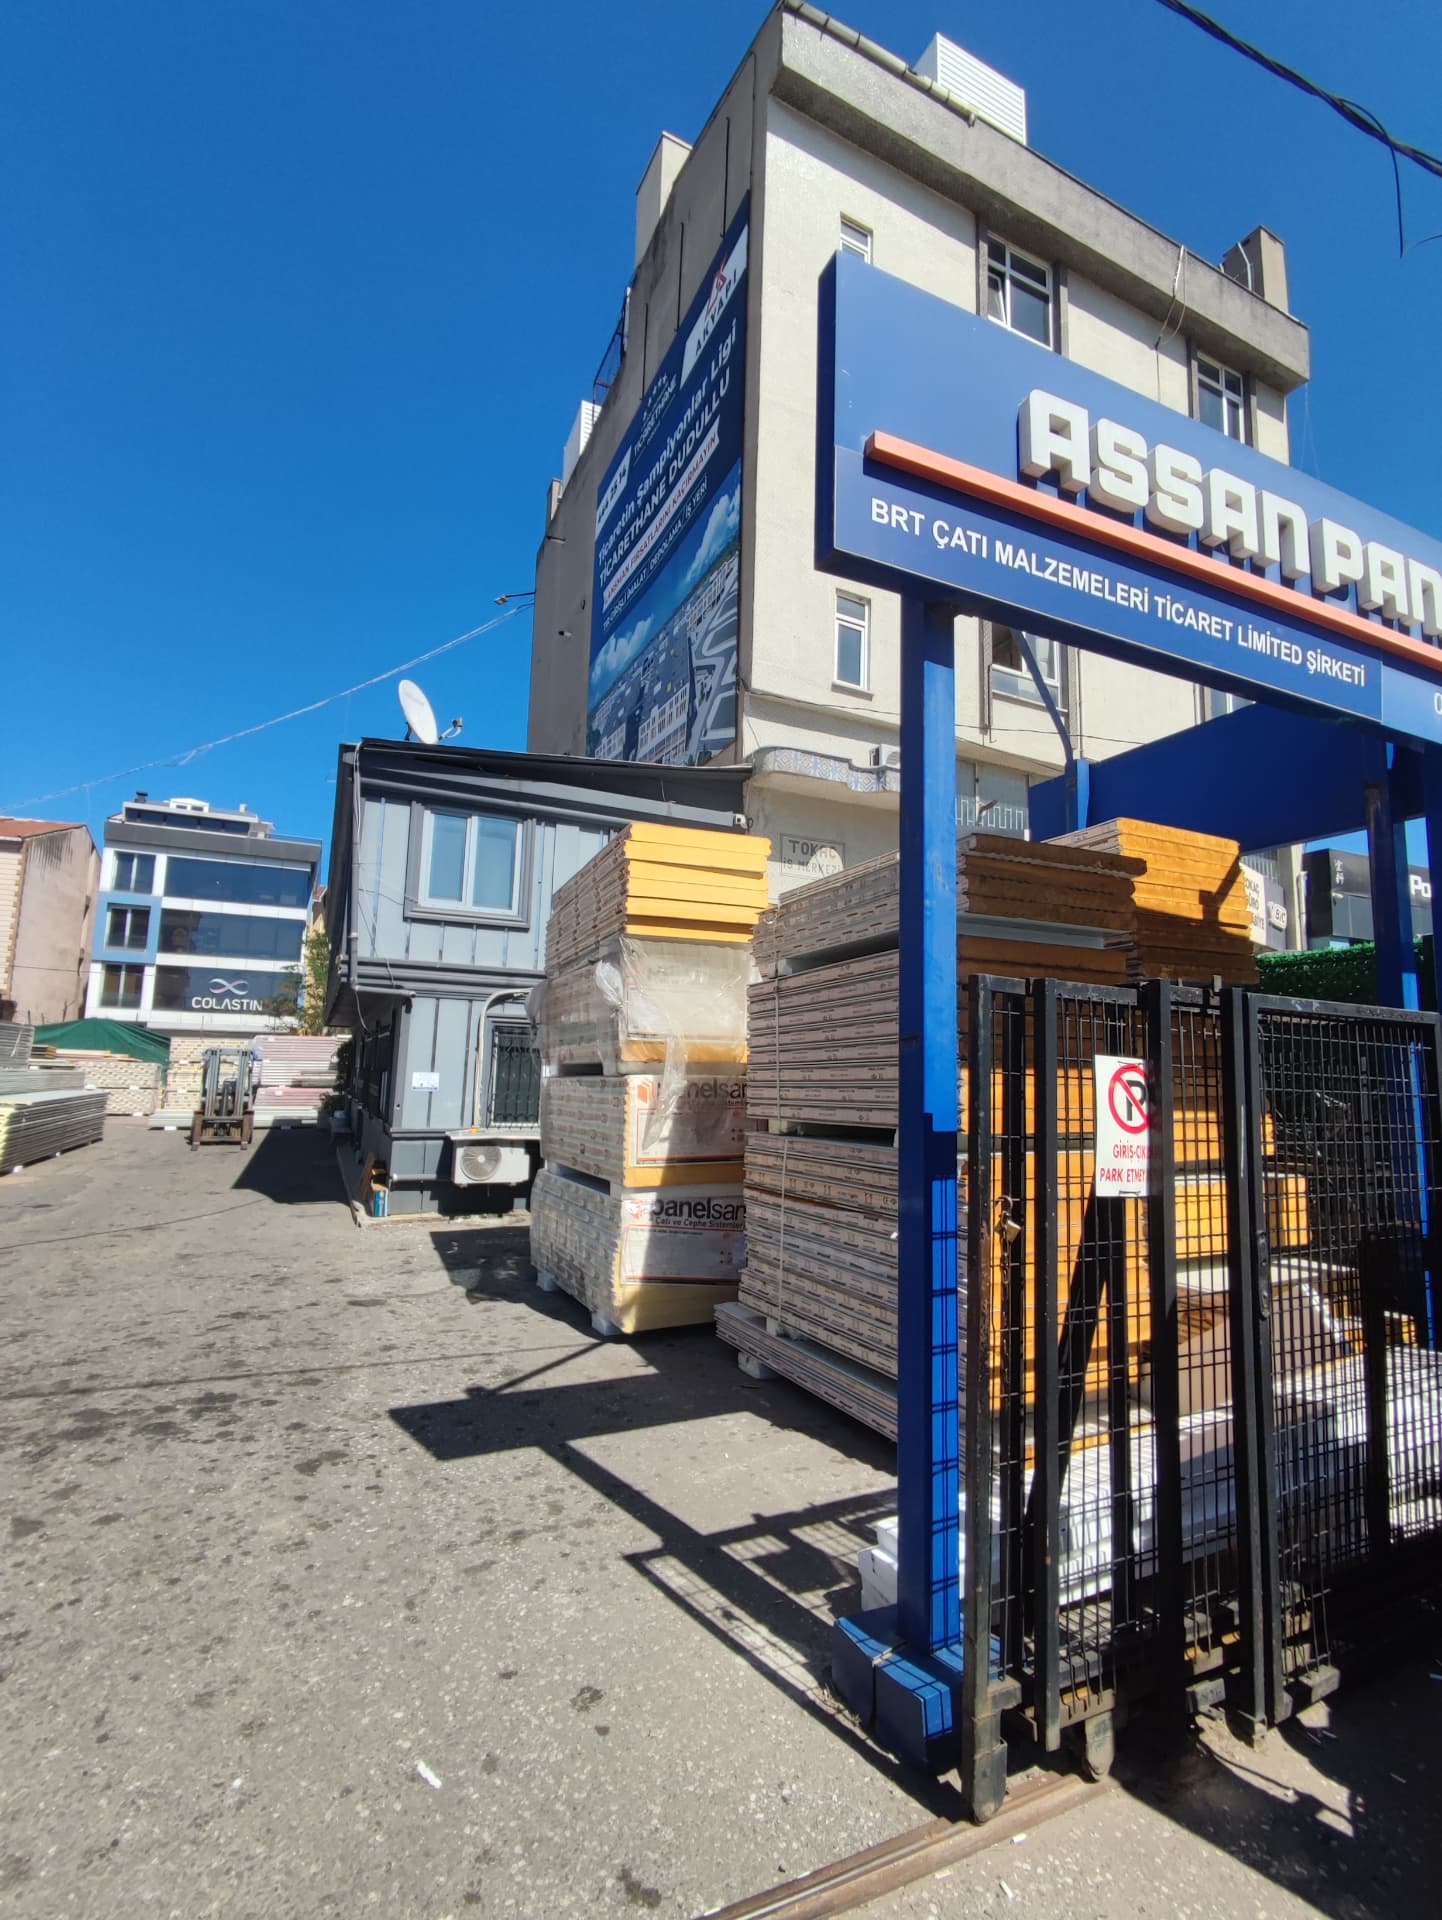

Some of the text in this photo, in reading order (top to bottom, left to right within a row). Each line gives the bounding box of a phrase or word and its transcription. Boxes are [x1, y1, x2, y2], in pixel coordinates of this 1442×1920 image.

[695, 268, 738, 357] AKYAPI
[711, 318, 737, 378] Ligi
[669, 367, 730, 485] DUDULLU
[871, 497, 1366, 688] BRT ÇATI MALZEMELERİ TİCARET LİMİTED ŞİRKETİ
[191, 996, 263, 1011] COLASTIN
[1100, 1167, 1123, 1183] PARK
